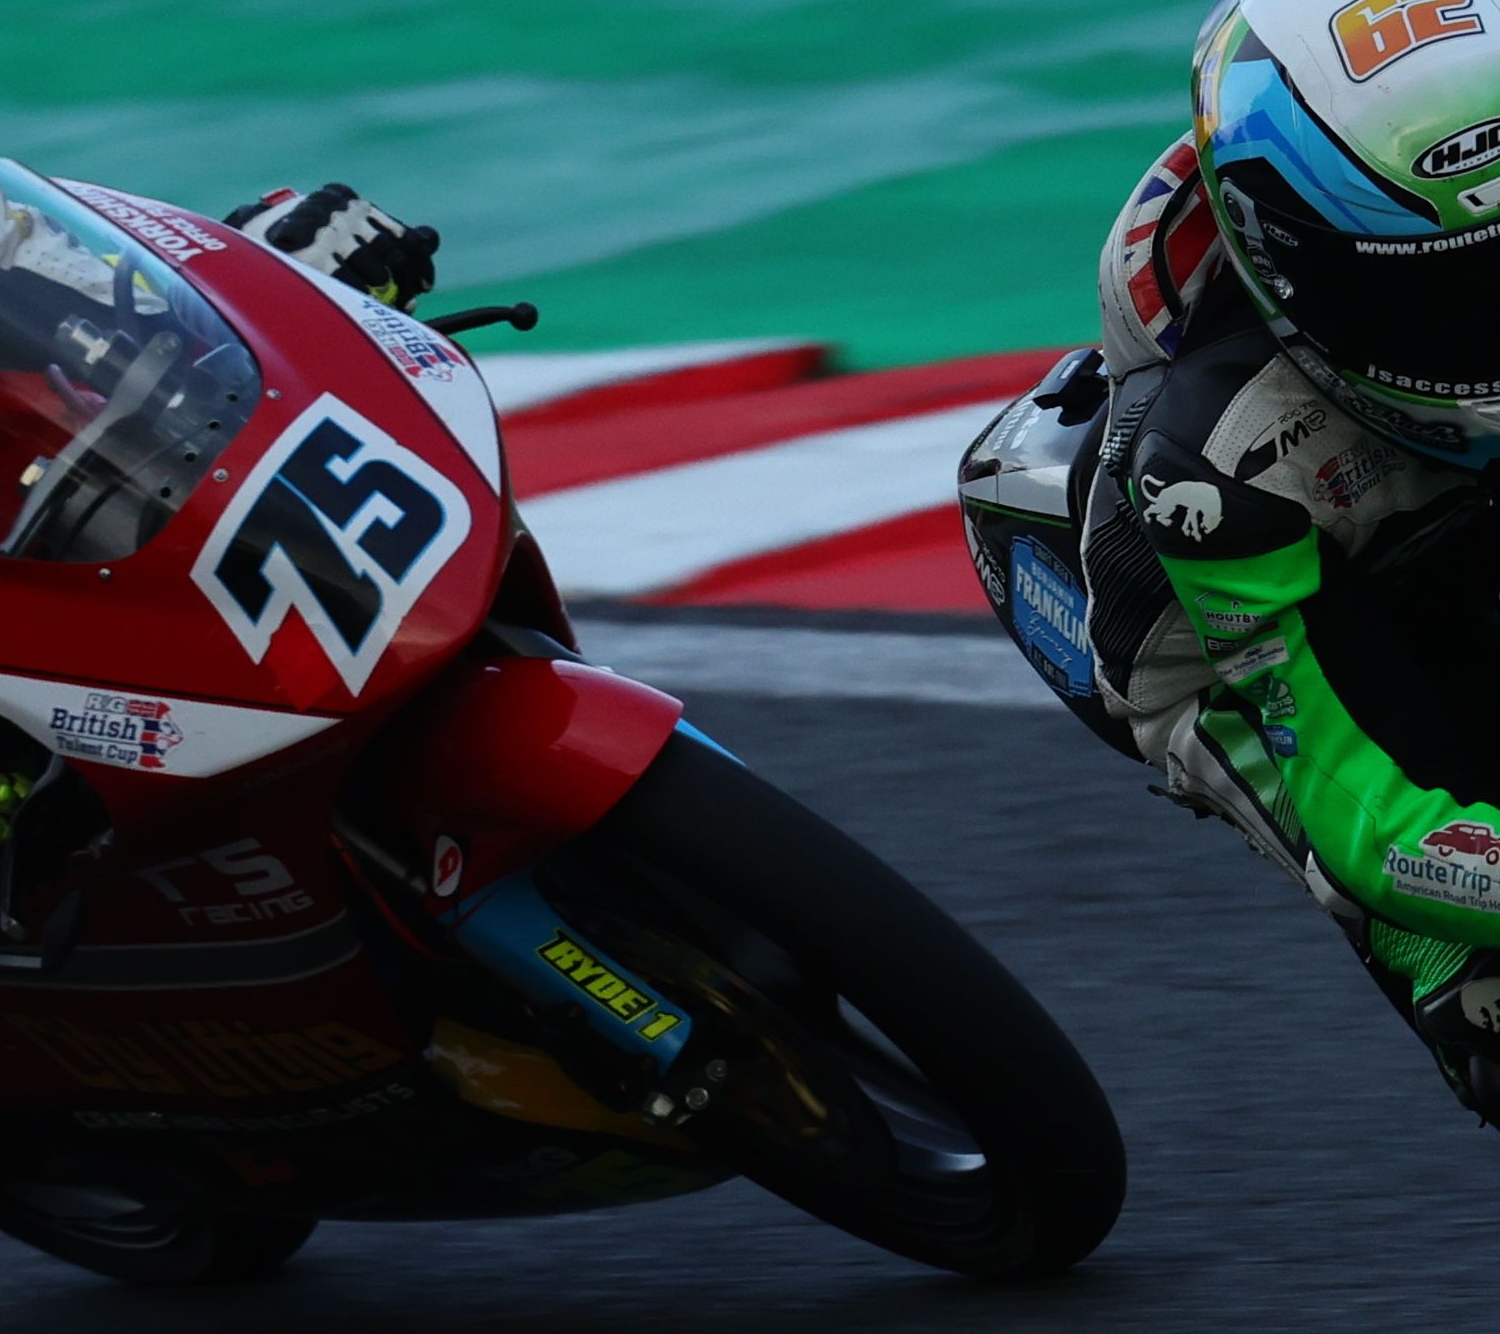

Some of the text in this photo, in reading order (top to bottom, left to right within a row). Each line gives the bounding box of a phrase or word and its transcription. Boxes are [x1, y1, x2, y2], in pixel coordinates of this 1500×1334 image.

[213, 416, 447, 657] 75
[1015, 561, 1088, 656] FRANKLIN
[50, 707, 138, 741] British
[106, 745, 138, 765] Cup
[1384, 847, 1492, 898] RouteTrip
[1443, 889, 1467, 905] Road
[537, 933, 684, 1043] RYDE 1
